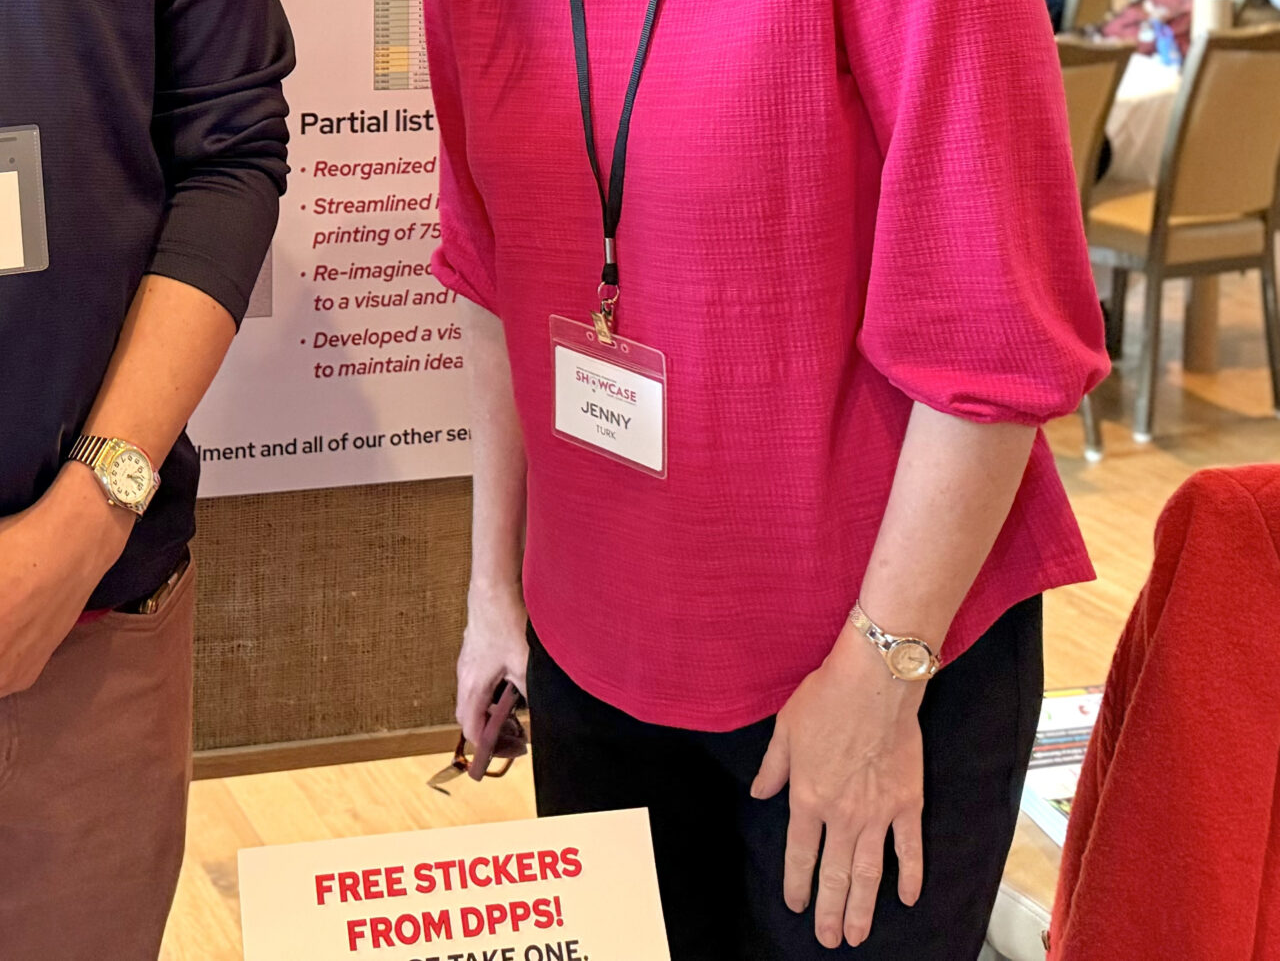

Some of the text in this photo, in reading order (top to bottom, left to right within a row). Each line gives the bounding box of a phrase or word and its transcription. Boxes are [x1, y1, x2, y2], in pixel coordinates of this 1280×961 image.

[300, 108, 434, 135] Partial list
[313, 156, 437, 180] Reorganized
[313, 193, 432, 215] Streamlined
[313, 225, 389, 249] printing
[394, 223, 416, 241] of
[313, 295, 334, 311] to
[338, 297, 350, 309] a
[355, 289, 409, 308] visual
[412, 288, 449, 306] and
[313, 323, 462, 348] Developed a vis
[313, 353, 464, 378] to maintain idea
[580, 401, 631, 430] JENNY
[198, 442, 256, 462] lment
[260, 437, 297, 457] and
[302, 436, 323, 454] all
[327, 433, 350, 452] of
[352, 434, 386, 450] our
[389, 427, 443, 447] other
[596, 424, 616, 440] TURK
[314, 847, 583, 906] FREE STICKERS
[346, 895, 565, 951] FROM DPPS!
[524, 939, 590, 961] ONE.
